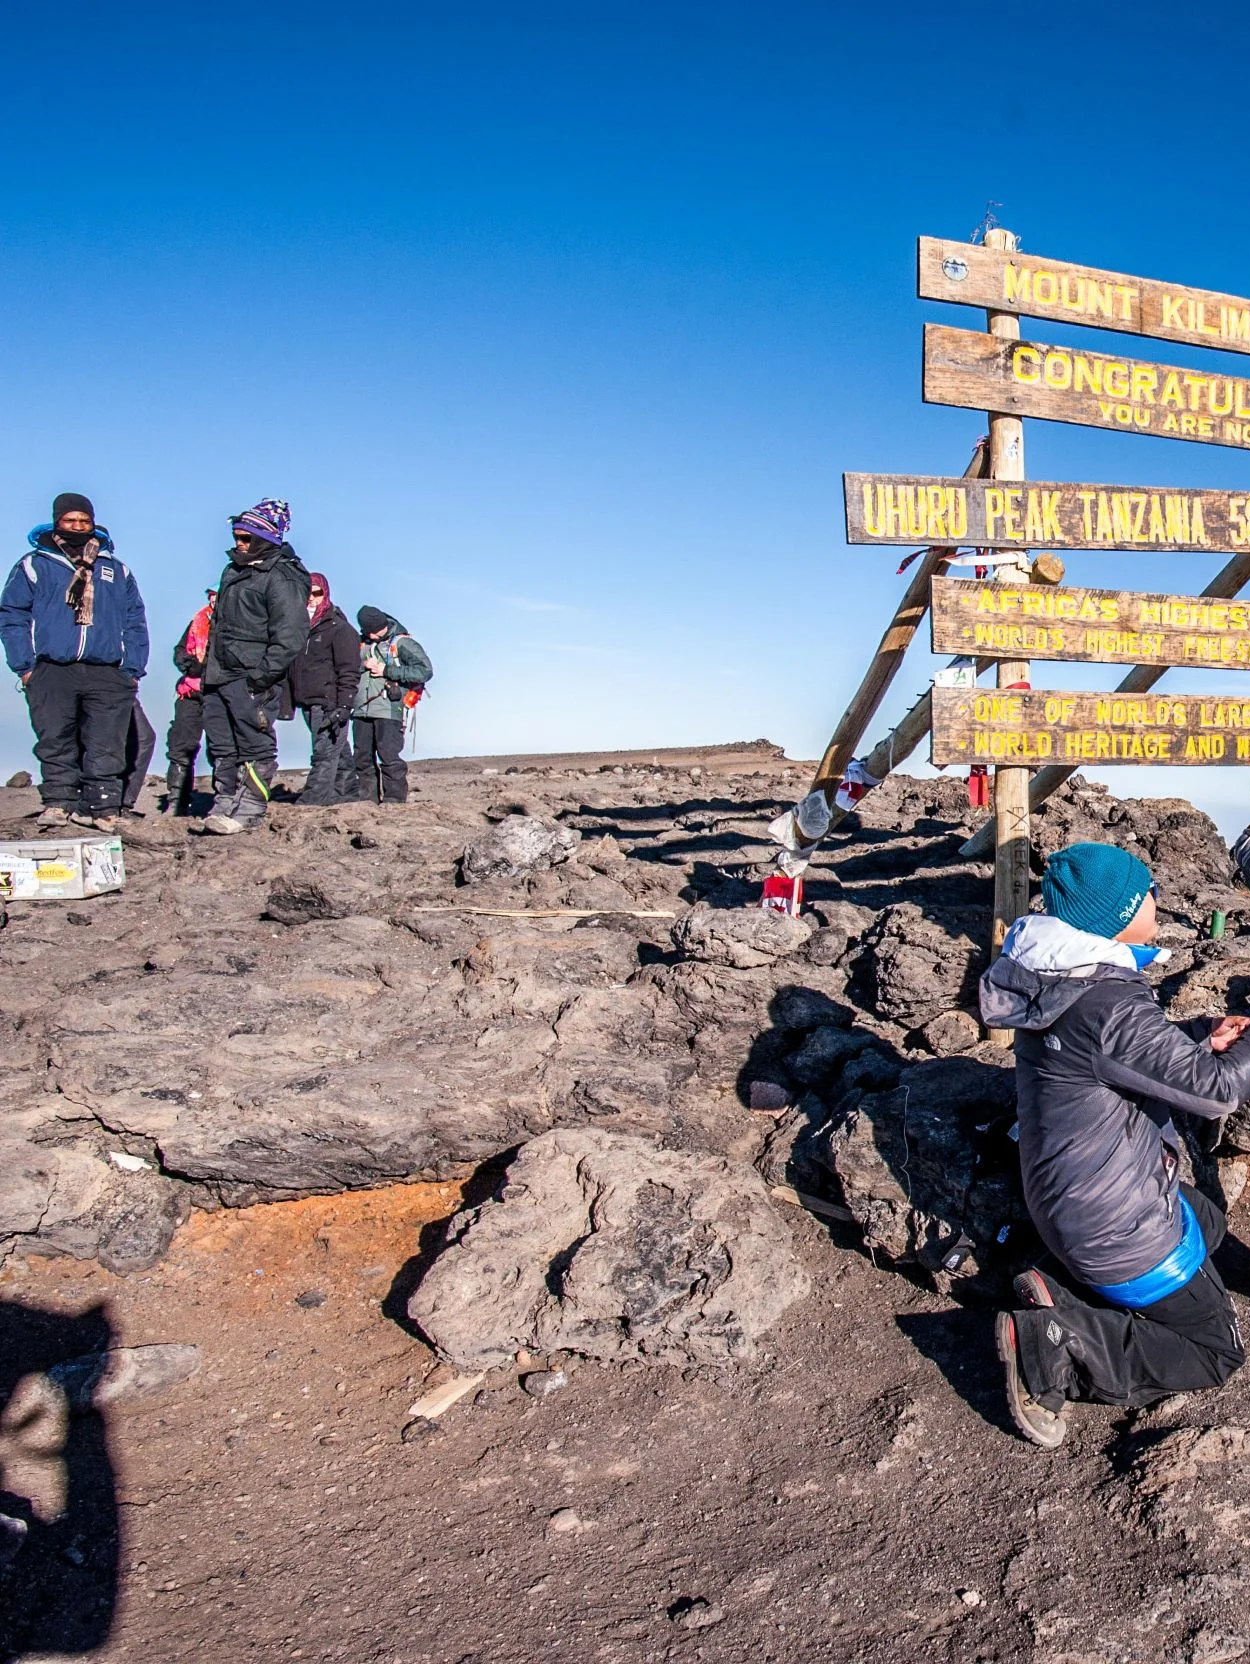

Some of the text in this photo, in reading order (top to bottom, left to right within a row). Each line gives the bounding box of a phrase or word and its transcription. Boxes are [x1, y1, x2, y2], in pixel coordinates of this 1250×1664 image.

[1004, 263, 1139, 320] MOUNT
[1099, 401, 1150, 426] YOU
[1163, 413, 1214, 437] ARE
[862, 484, 968, 538] UHURU
[985, 487, 1064, 541] PEAK
[1076, 491, 1206, 545] TANZANIA
[1086, 629, 1165, 657] HIGHEST
[974, 696, 1023, 723] ONE
[1045, 699, 1076, 725] OF
[974, 731, 1052, 758] WORLD
[1065, 732, 1171, 759] HERITAGE
[1185, 735, 1225, 759] AND
